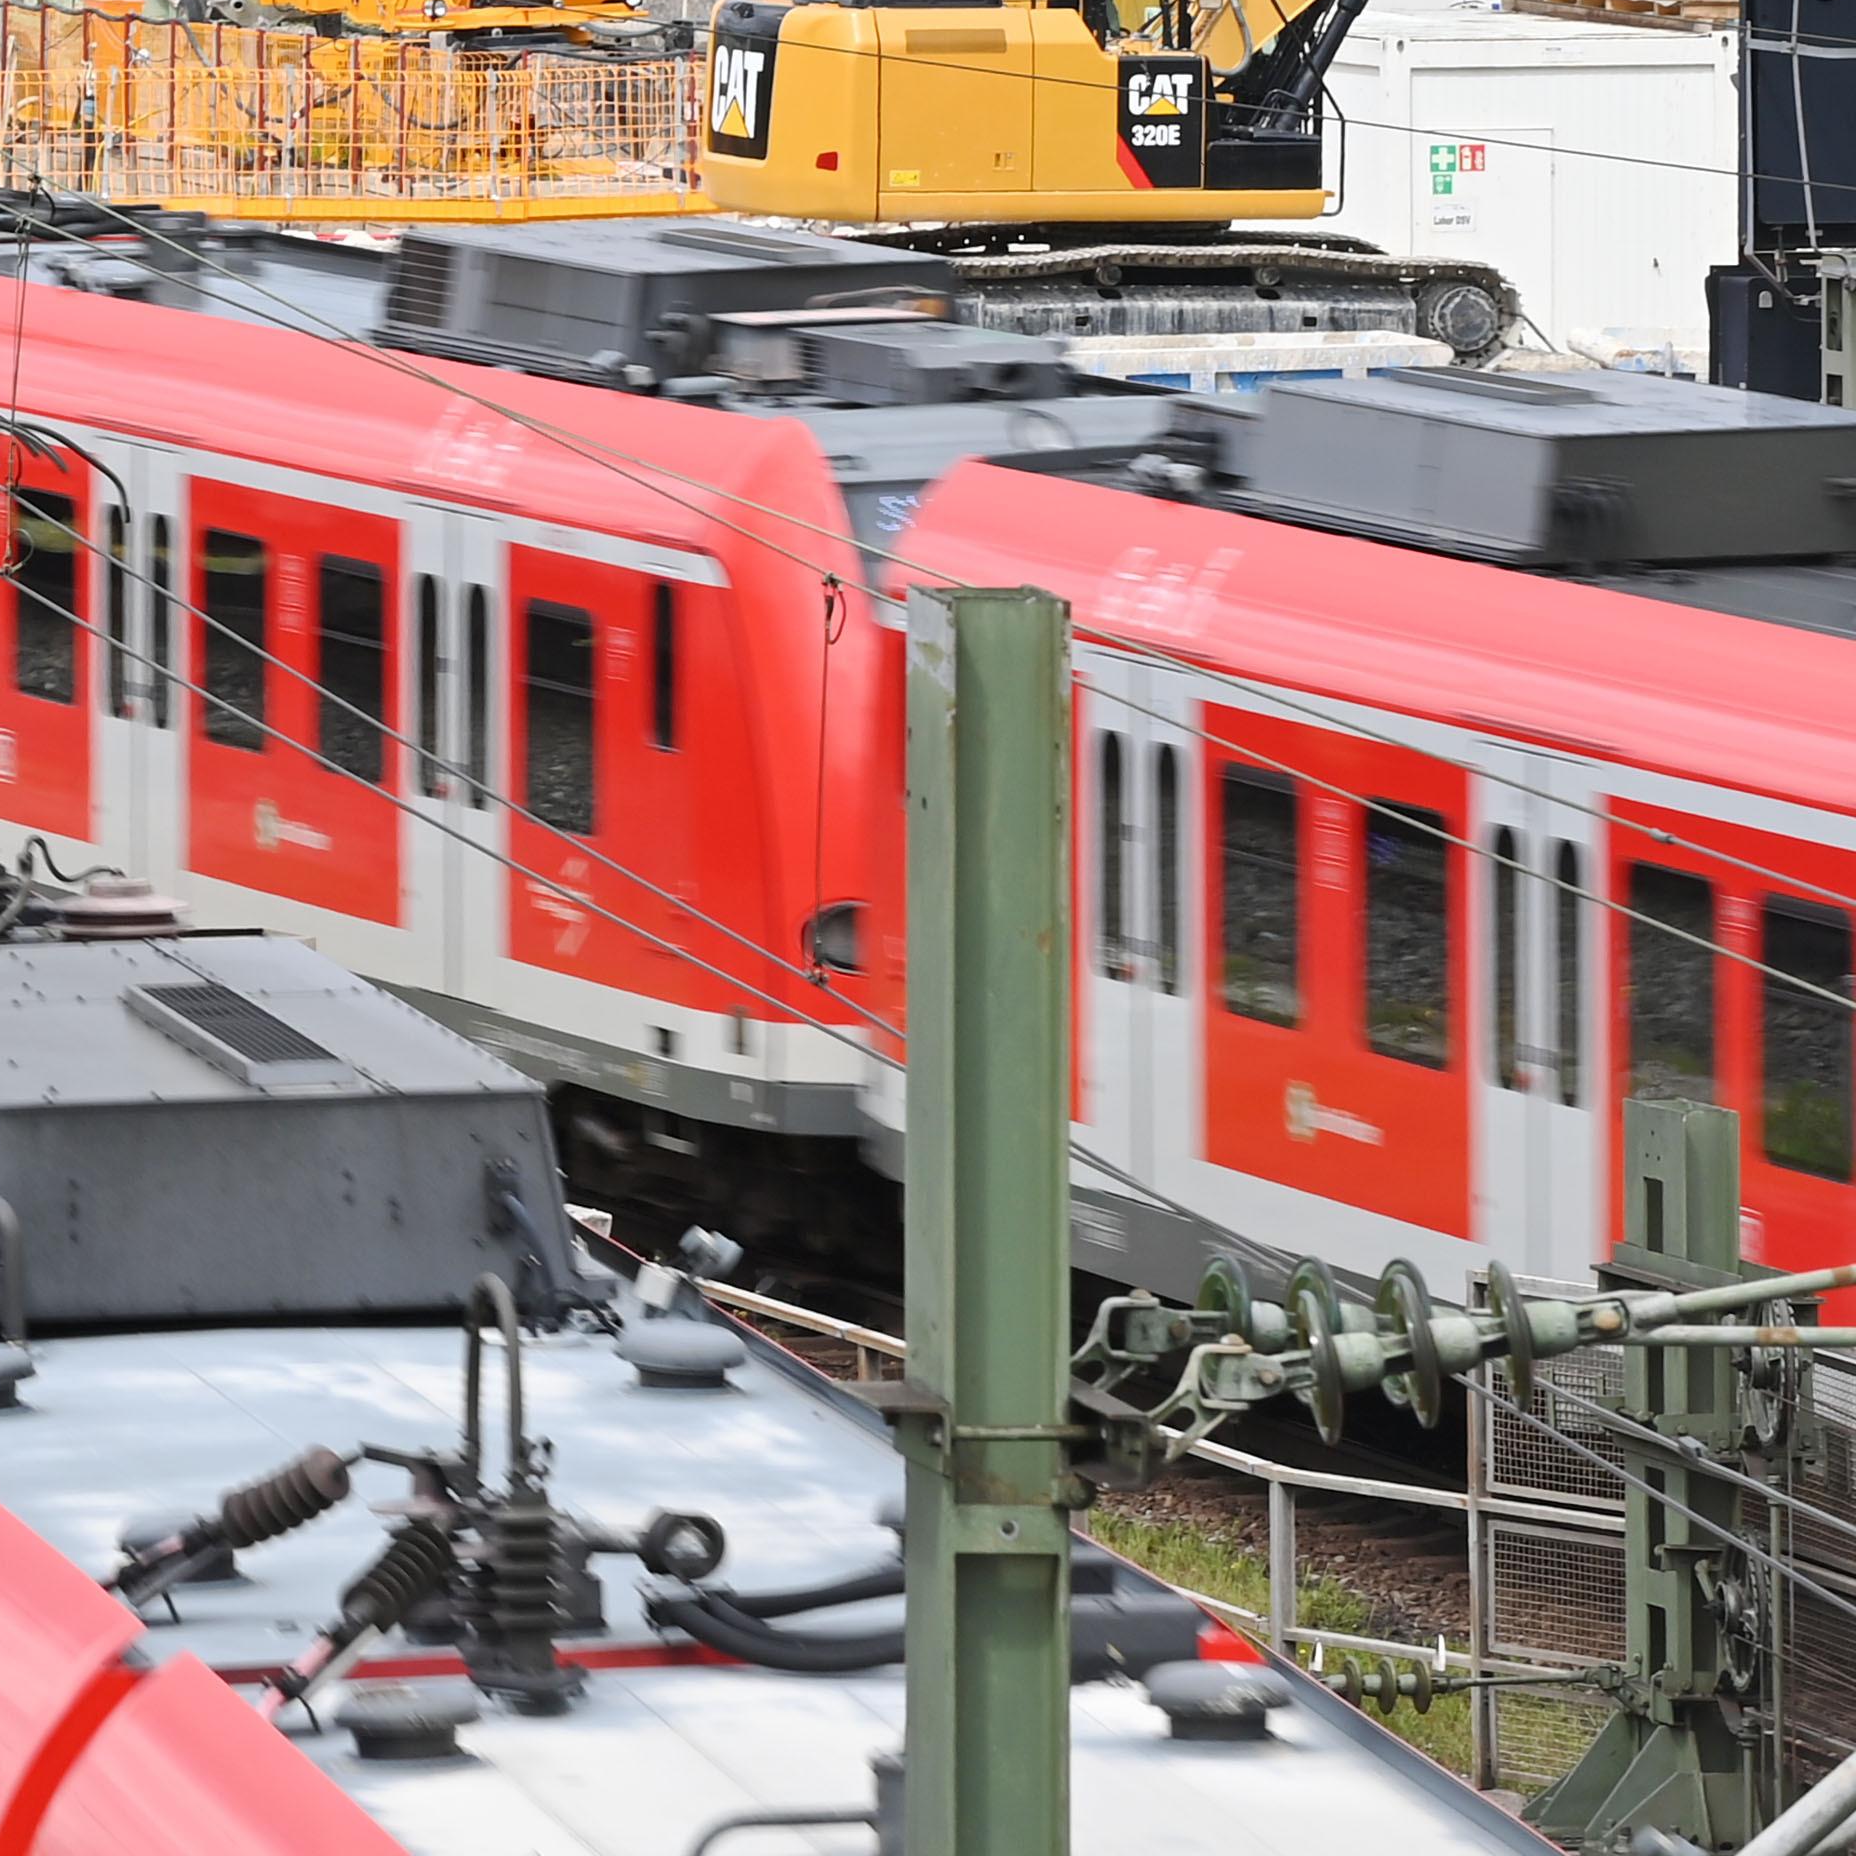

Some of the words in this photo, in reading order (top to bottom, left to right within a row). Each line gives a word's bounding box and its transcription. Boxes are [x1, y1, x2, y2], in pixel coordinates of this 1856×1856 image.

[711, 44, 765, 139] CAT
[1128, 73, 1193, 116] CAT
[1131, 124, 1181, 147] 320E
